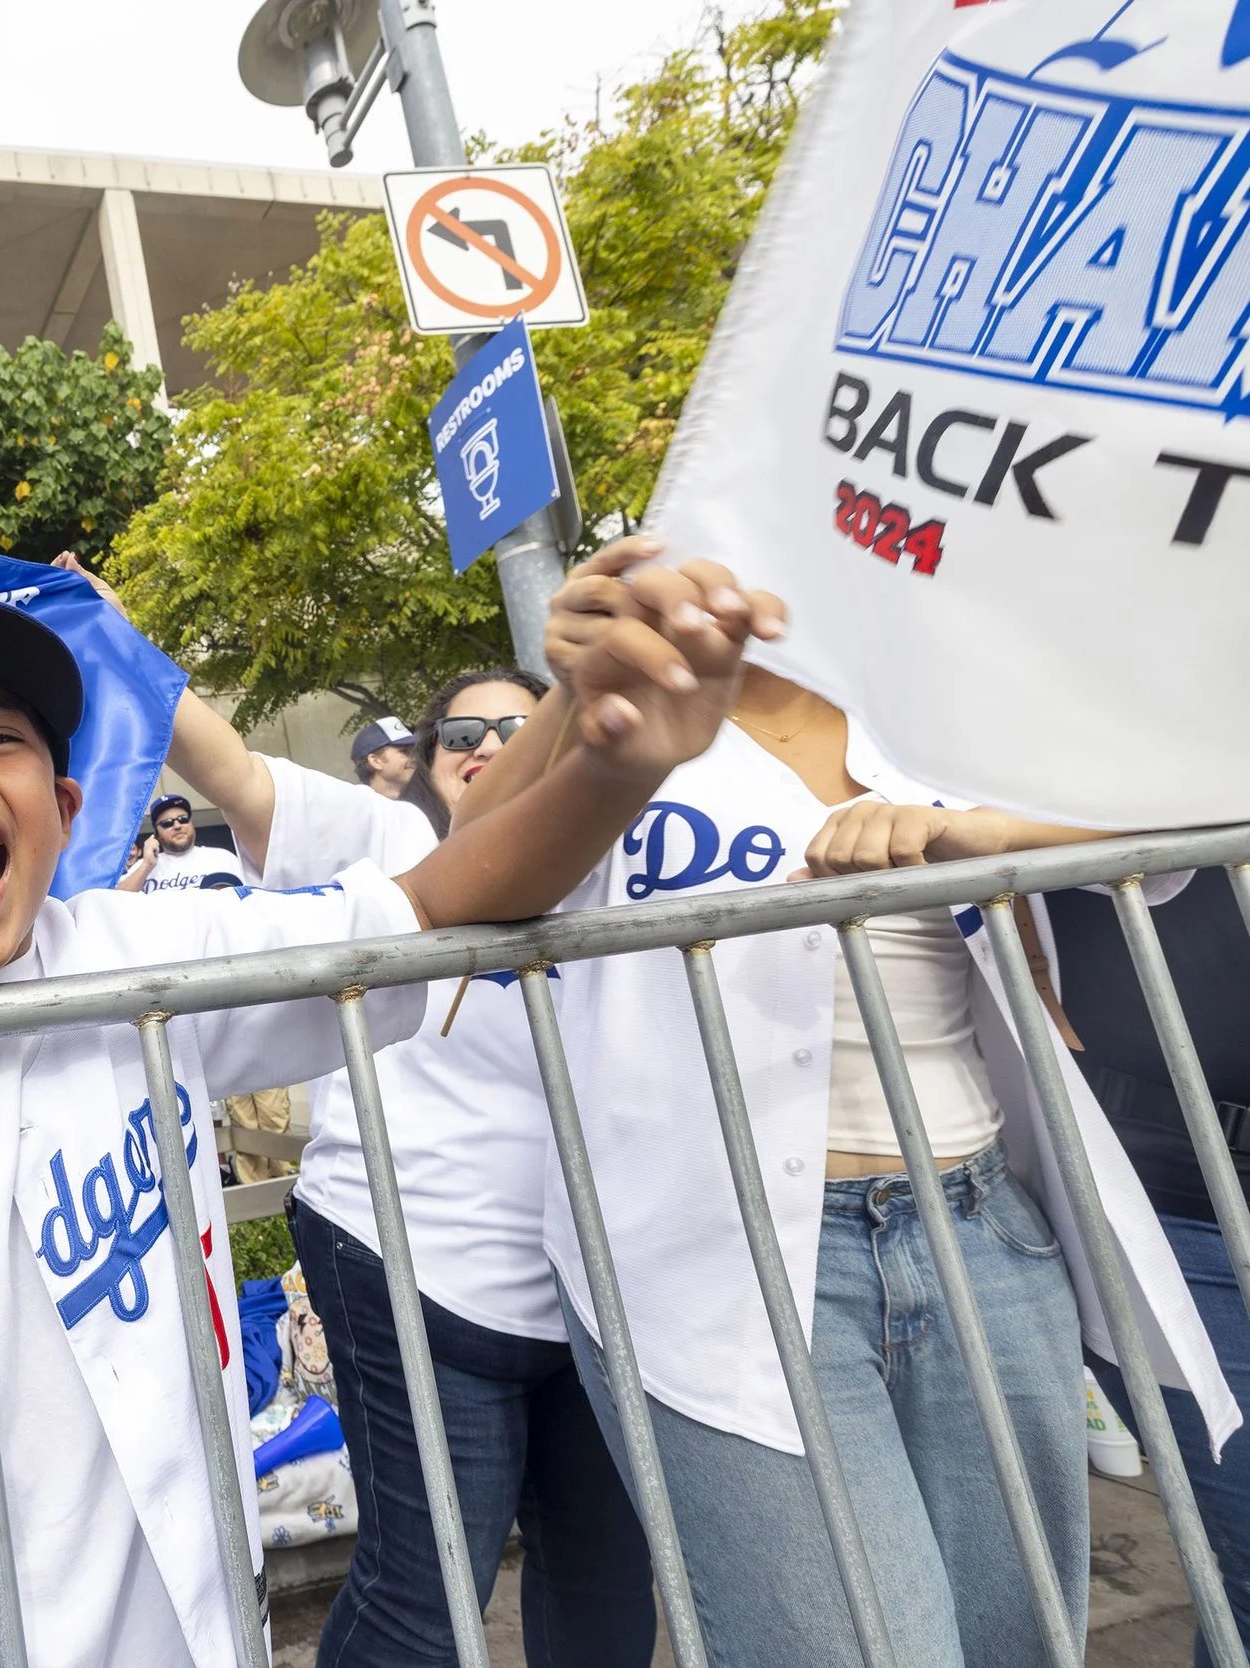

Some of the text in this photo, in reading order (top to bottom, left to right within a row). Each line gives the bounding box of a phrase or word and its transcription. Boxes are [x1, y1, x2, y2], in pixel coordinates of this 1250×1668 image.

[435, 347, 525, 453] RESTROOMS
[821, 370, 1098, 522] BACK
[833, 478, 946, 577] 2024
[624, 801, 786, 900] Do
